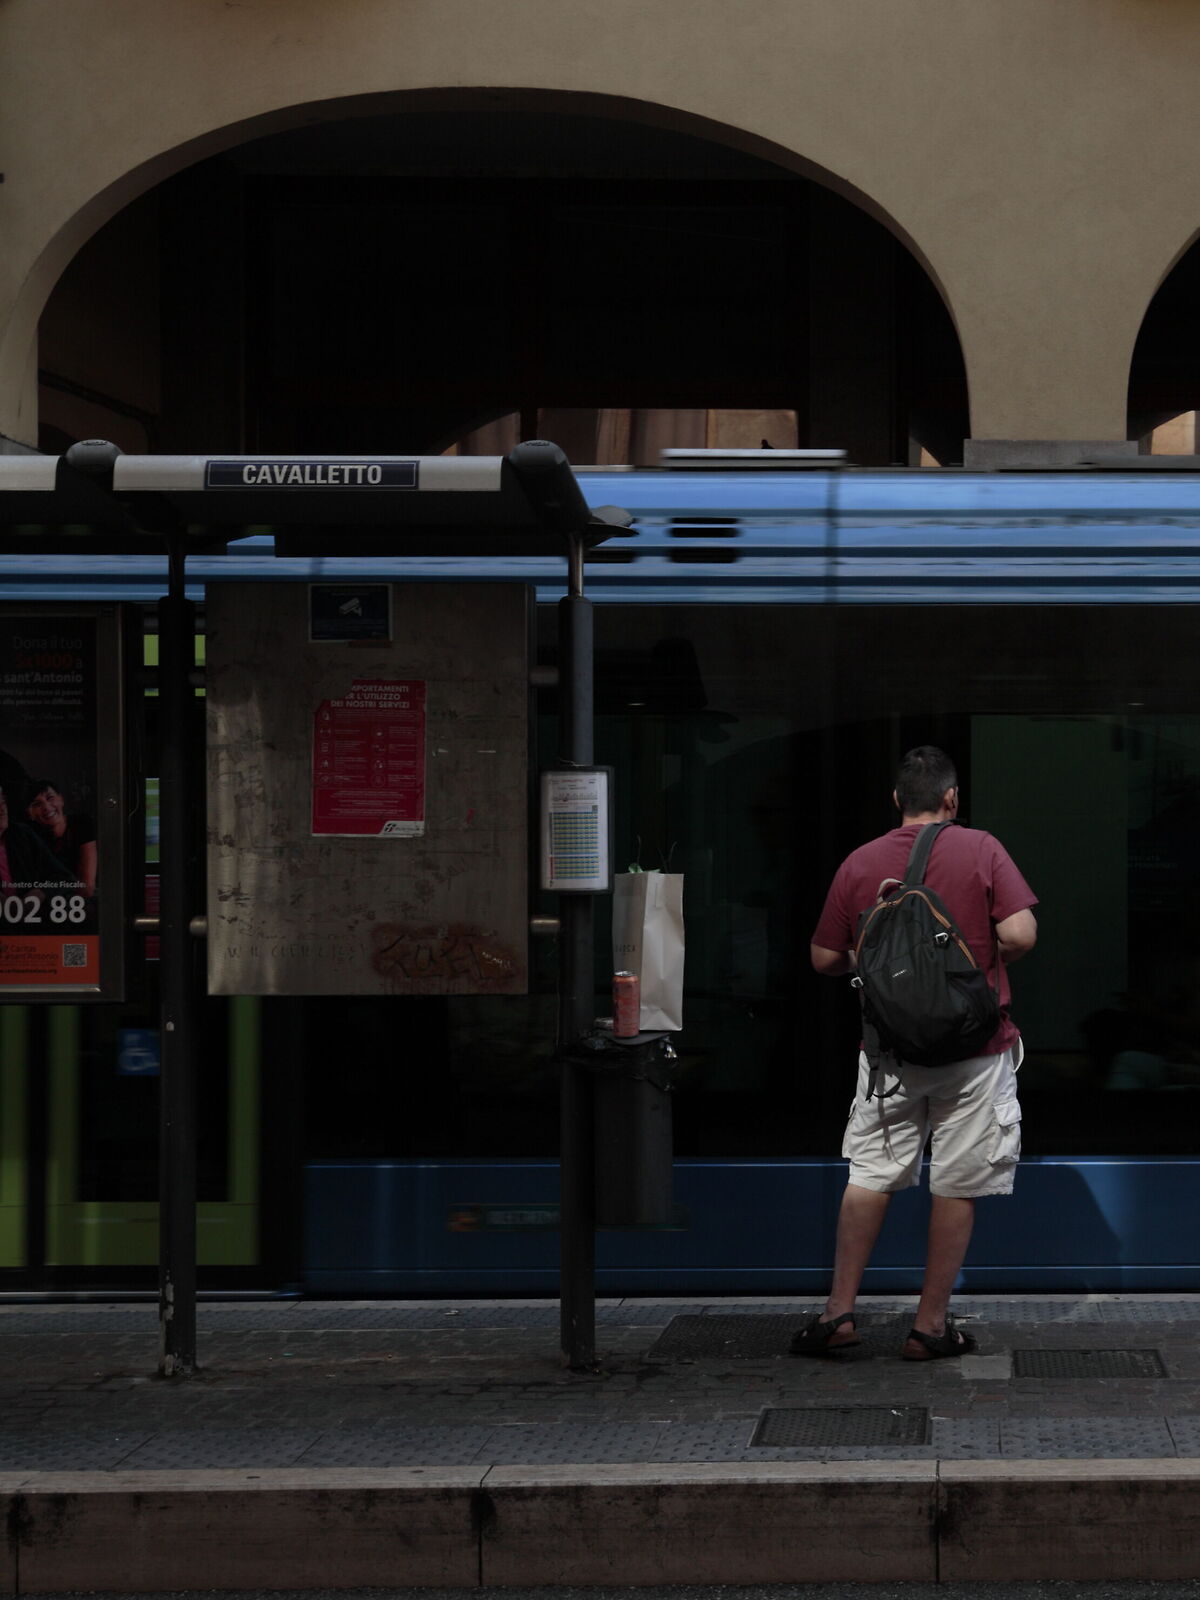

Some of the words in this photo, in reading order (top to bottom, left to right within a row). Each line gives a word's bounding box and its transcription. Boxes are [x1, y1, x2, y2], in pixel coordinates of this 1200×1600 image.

[242, 464, 382, 485] CAVALLETTO
[3, 671, 84, 684] sant'Antonio
[356, 692, 401, 701] L'UTILIZZO
[345, 700, 377, 709] NOSTRI
[378, 701, 410, 709] SERVIZI
[8, 881, 32, 889] nostro
[33, 880, 59, 889] Codice
[0, 895, 42, 924] 02
[49, 895, 87, 924] 88
